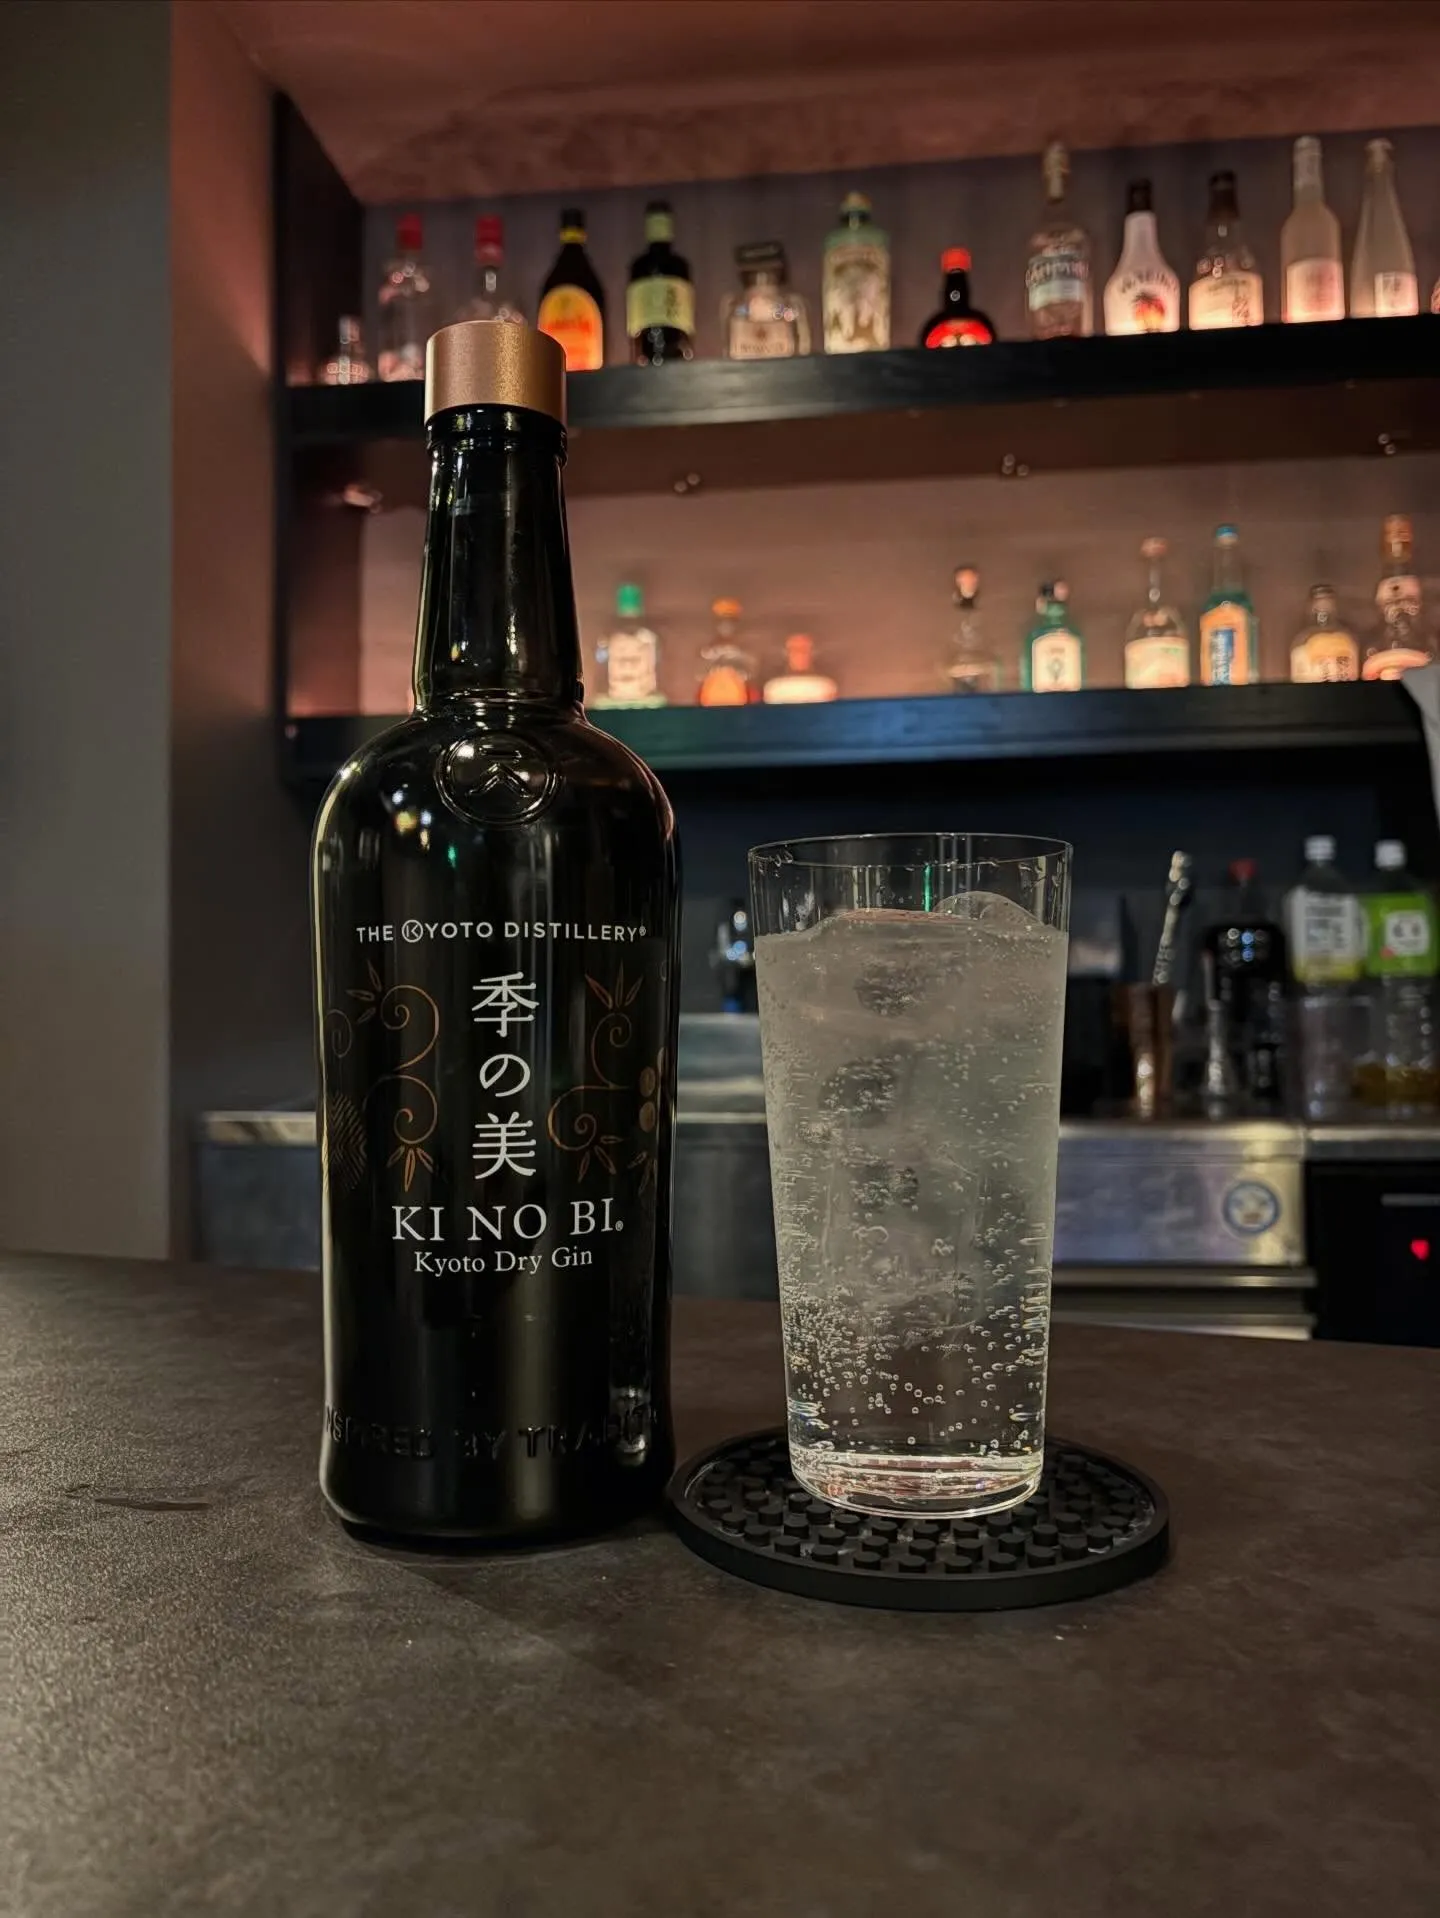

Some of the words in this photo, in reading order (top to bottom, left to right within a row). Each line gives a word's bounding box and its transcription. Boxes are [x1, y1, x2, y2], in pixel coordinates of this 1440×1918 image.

[356, 924, 394, 943] THE
[401, 919, 494, 943] KYOTO
[471, 971, 540, 1180] 季の美
[391, 1205, 445, 1241] KI
[466, 1203, 547, 1241] NO
[414, 1251, 486, 1278] Kyoto
[494, 1250, 543, 1276] Dry
[551, 1245, 593, 1268] Gin
